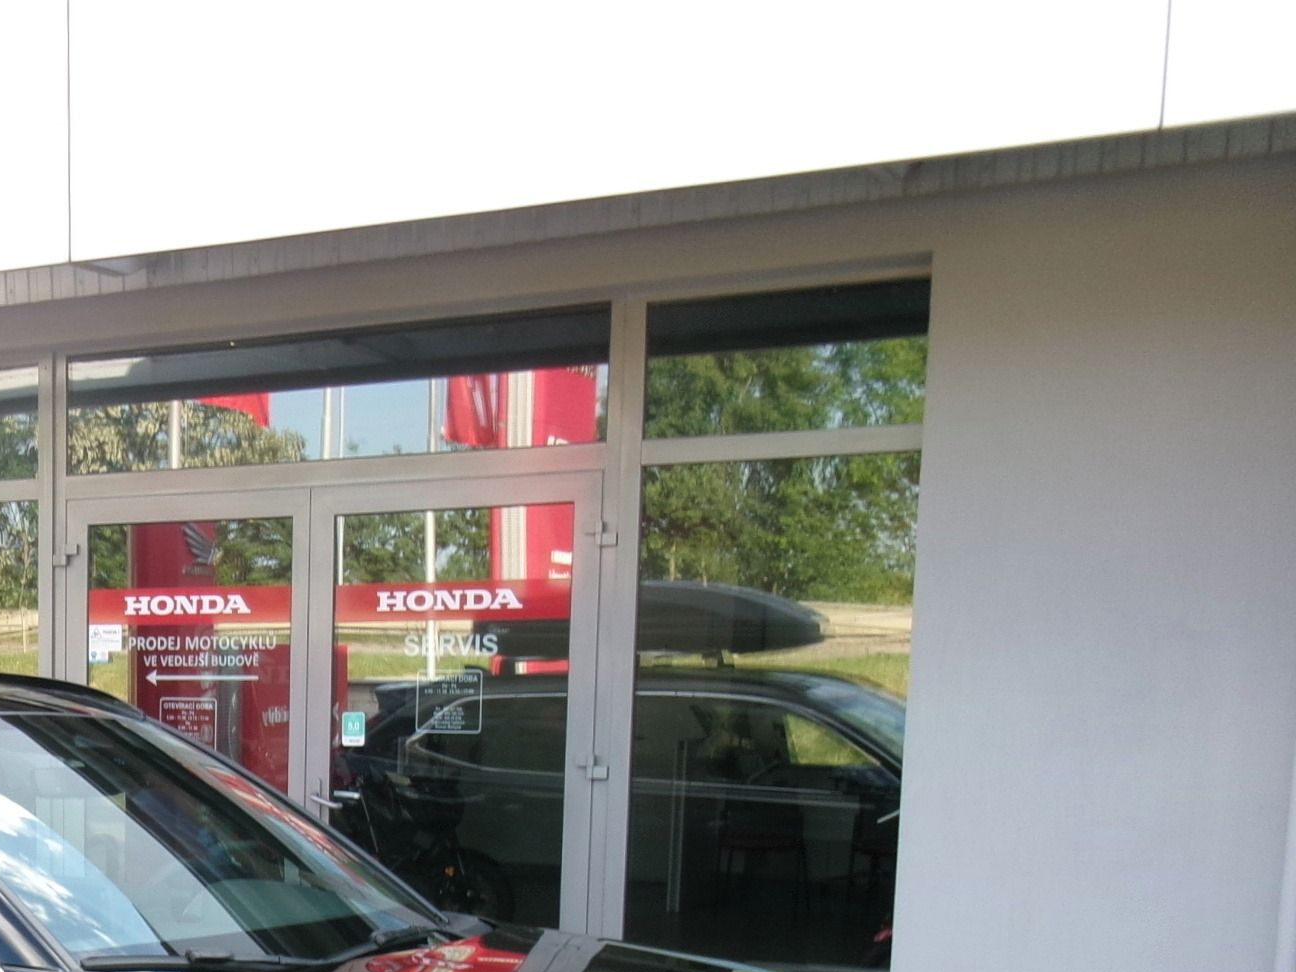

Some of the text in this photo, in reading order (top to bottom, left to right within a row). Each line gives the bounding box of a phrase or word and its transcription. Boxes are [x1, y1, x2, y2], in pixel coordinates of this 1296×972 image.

[124, 594, 251, 615] HONDA
[376, 588, 523, 612] HONDA
[128, 630, 277, 651] PRODEJ MOTOCYKLŮ
[404, 632, 499, 656] SERVIS
[143, 651, 260, 667] VE VEDLEJŠÍ BUDOVĚ
